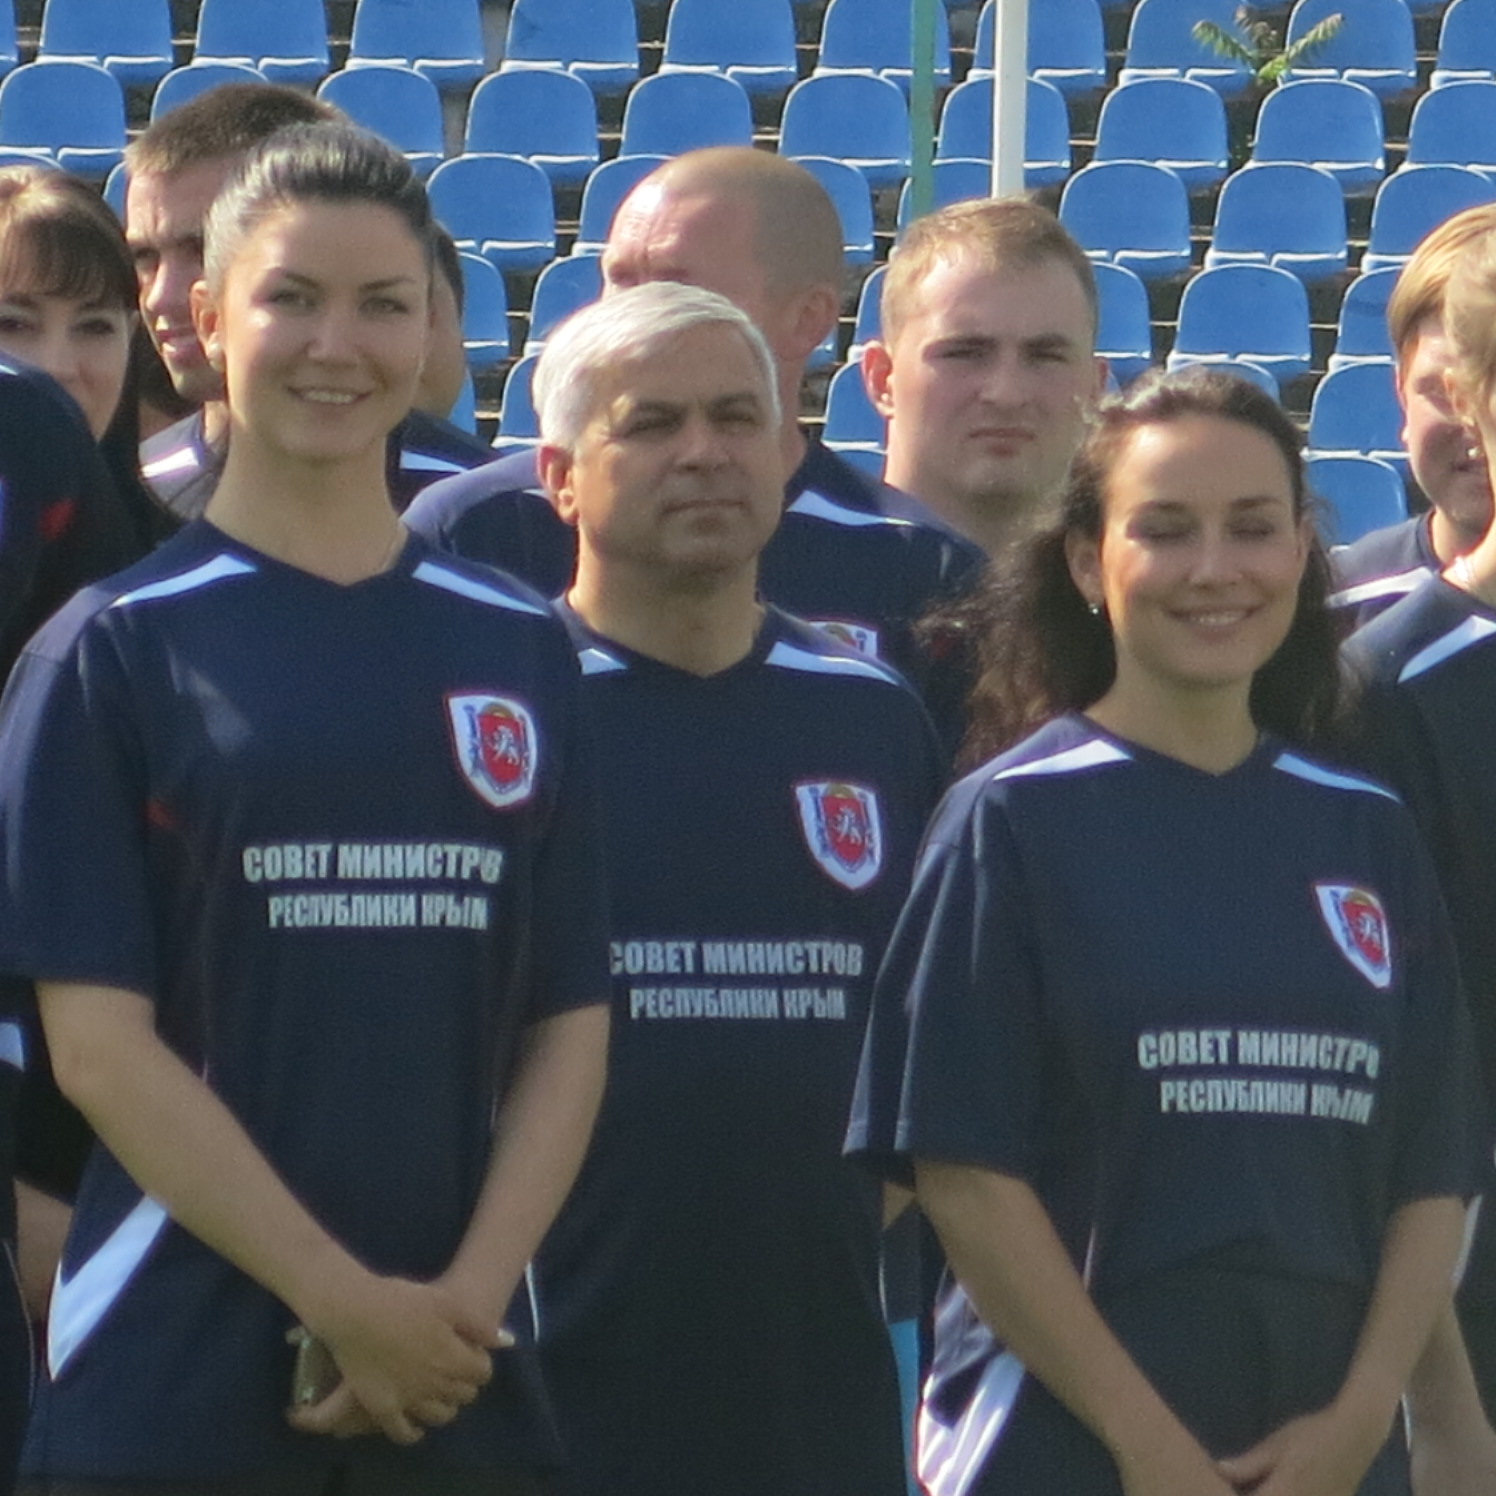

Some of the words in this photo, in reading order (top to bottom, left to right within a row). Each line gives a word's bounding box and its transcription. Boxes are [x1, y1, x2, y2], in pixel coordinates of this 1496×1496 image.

[243, 843, 332, 883] СОВЕТ
[268, 893, 417, 928] РЕСПУБЛИКИ
[420, 894, 488, 930] КРЫМ
[609, 941, 697, 975] СОВЕТ
[701, 941, 863, 976] МИНИСТРОВ
[630, 987, 779, 1020] РЕСПУБЛИКИ
[782, 988, 846, 1020] КРЫМ
[1137, 1029, 1232, 1070] СОВЕТ
[1160, 1079, 1307, 1115] РЕСПУБЛИКИ
